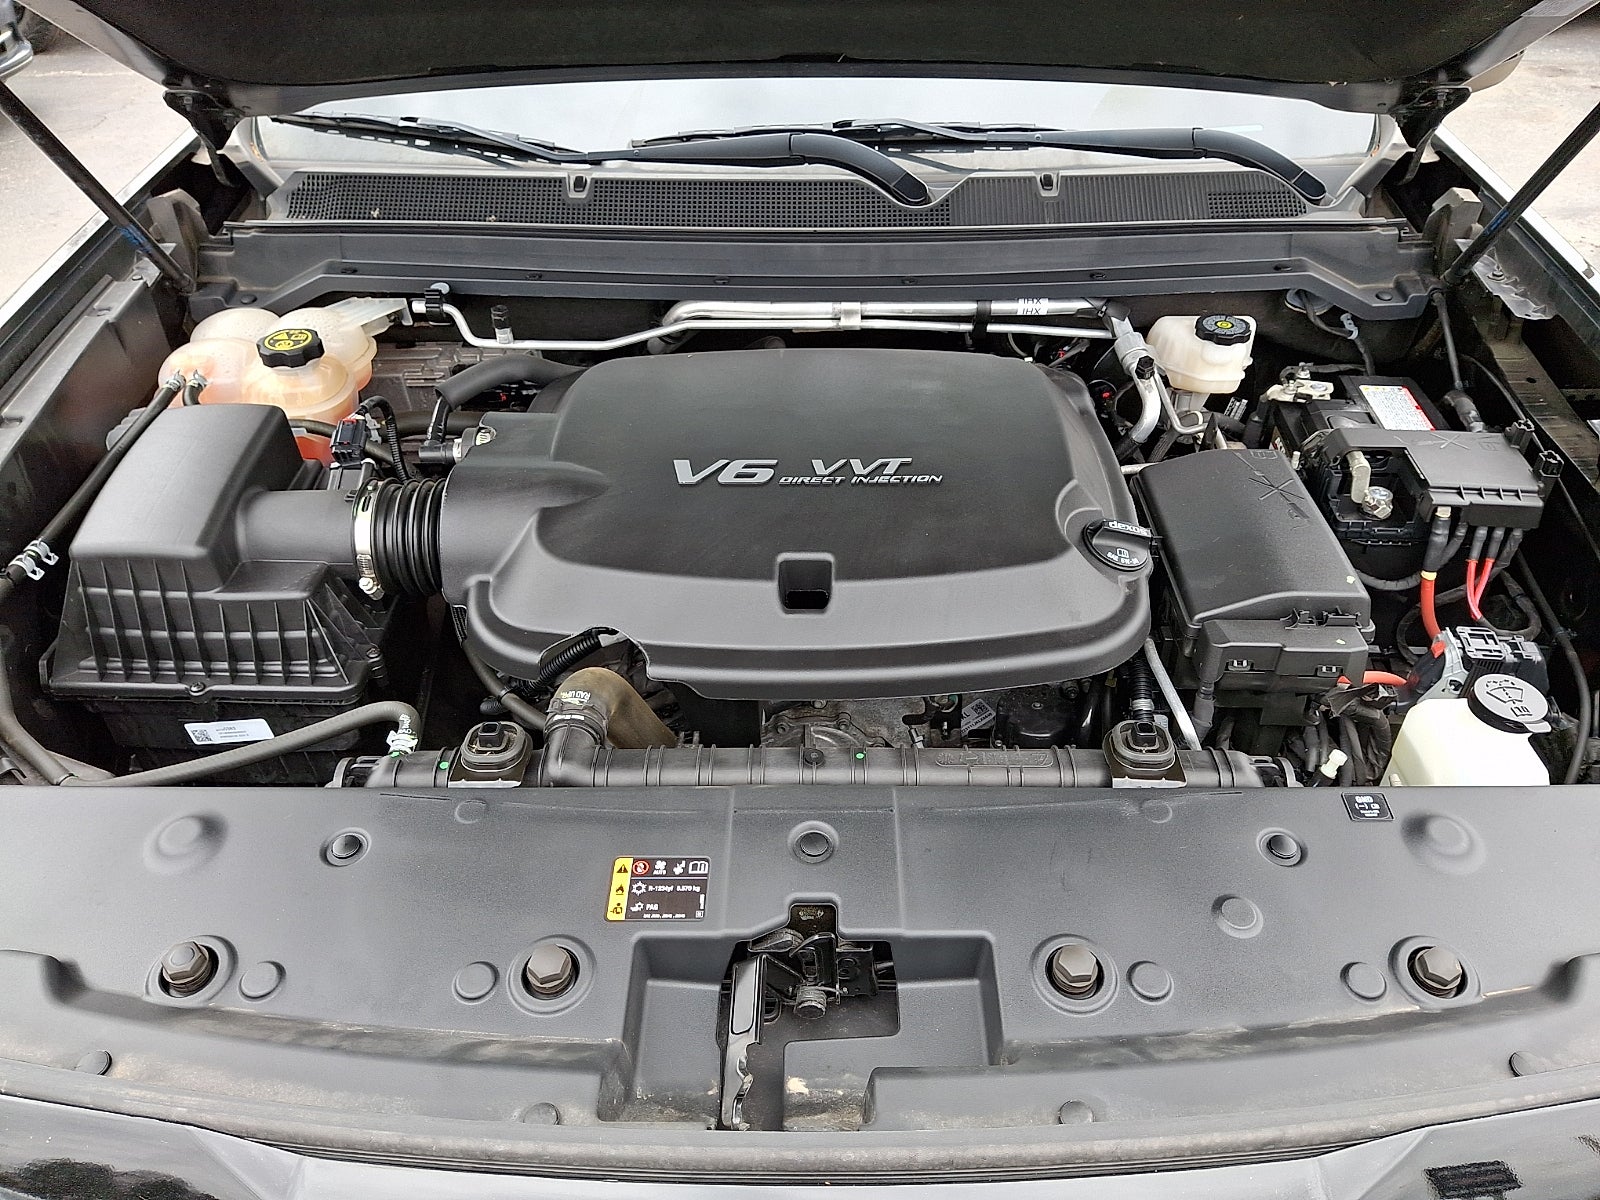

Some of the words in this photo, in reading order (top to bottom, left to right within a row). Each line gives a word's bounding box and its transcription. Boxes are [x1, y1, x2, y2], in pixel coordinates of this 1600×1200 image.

[673, 459, 778, 485] V6
[811, 458, 913, 475] VVT
[778, 476, 846, 485] DIRECT
[851, 475, 943, 484] INJECTION
